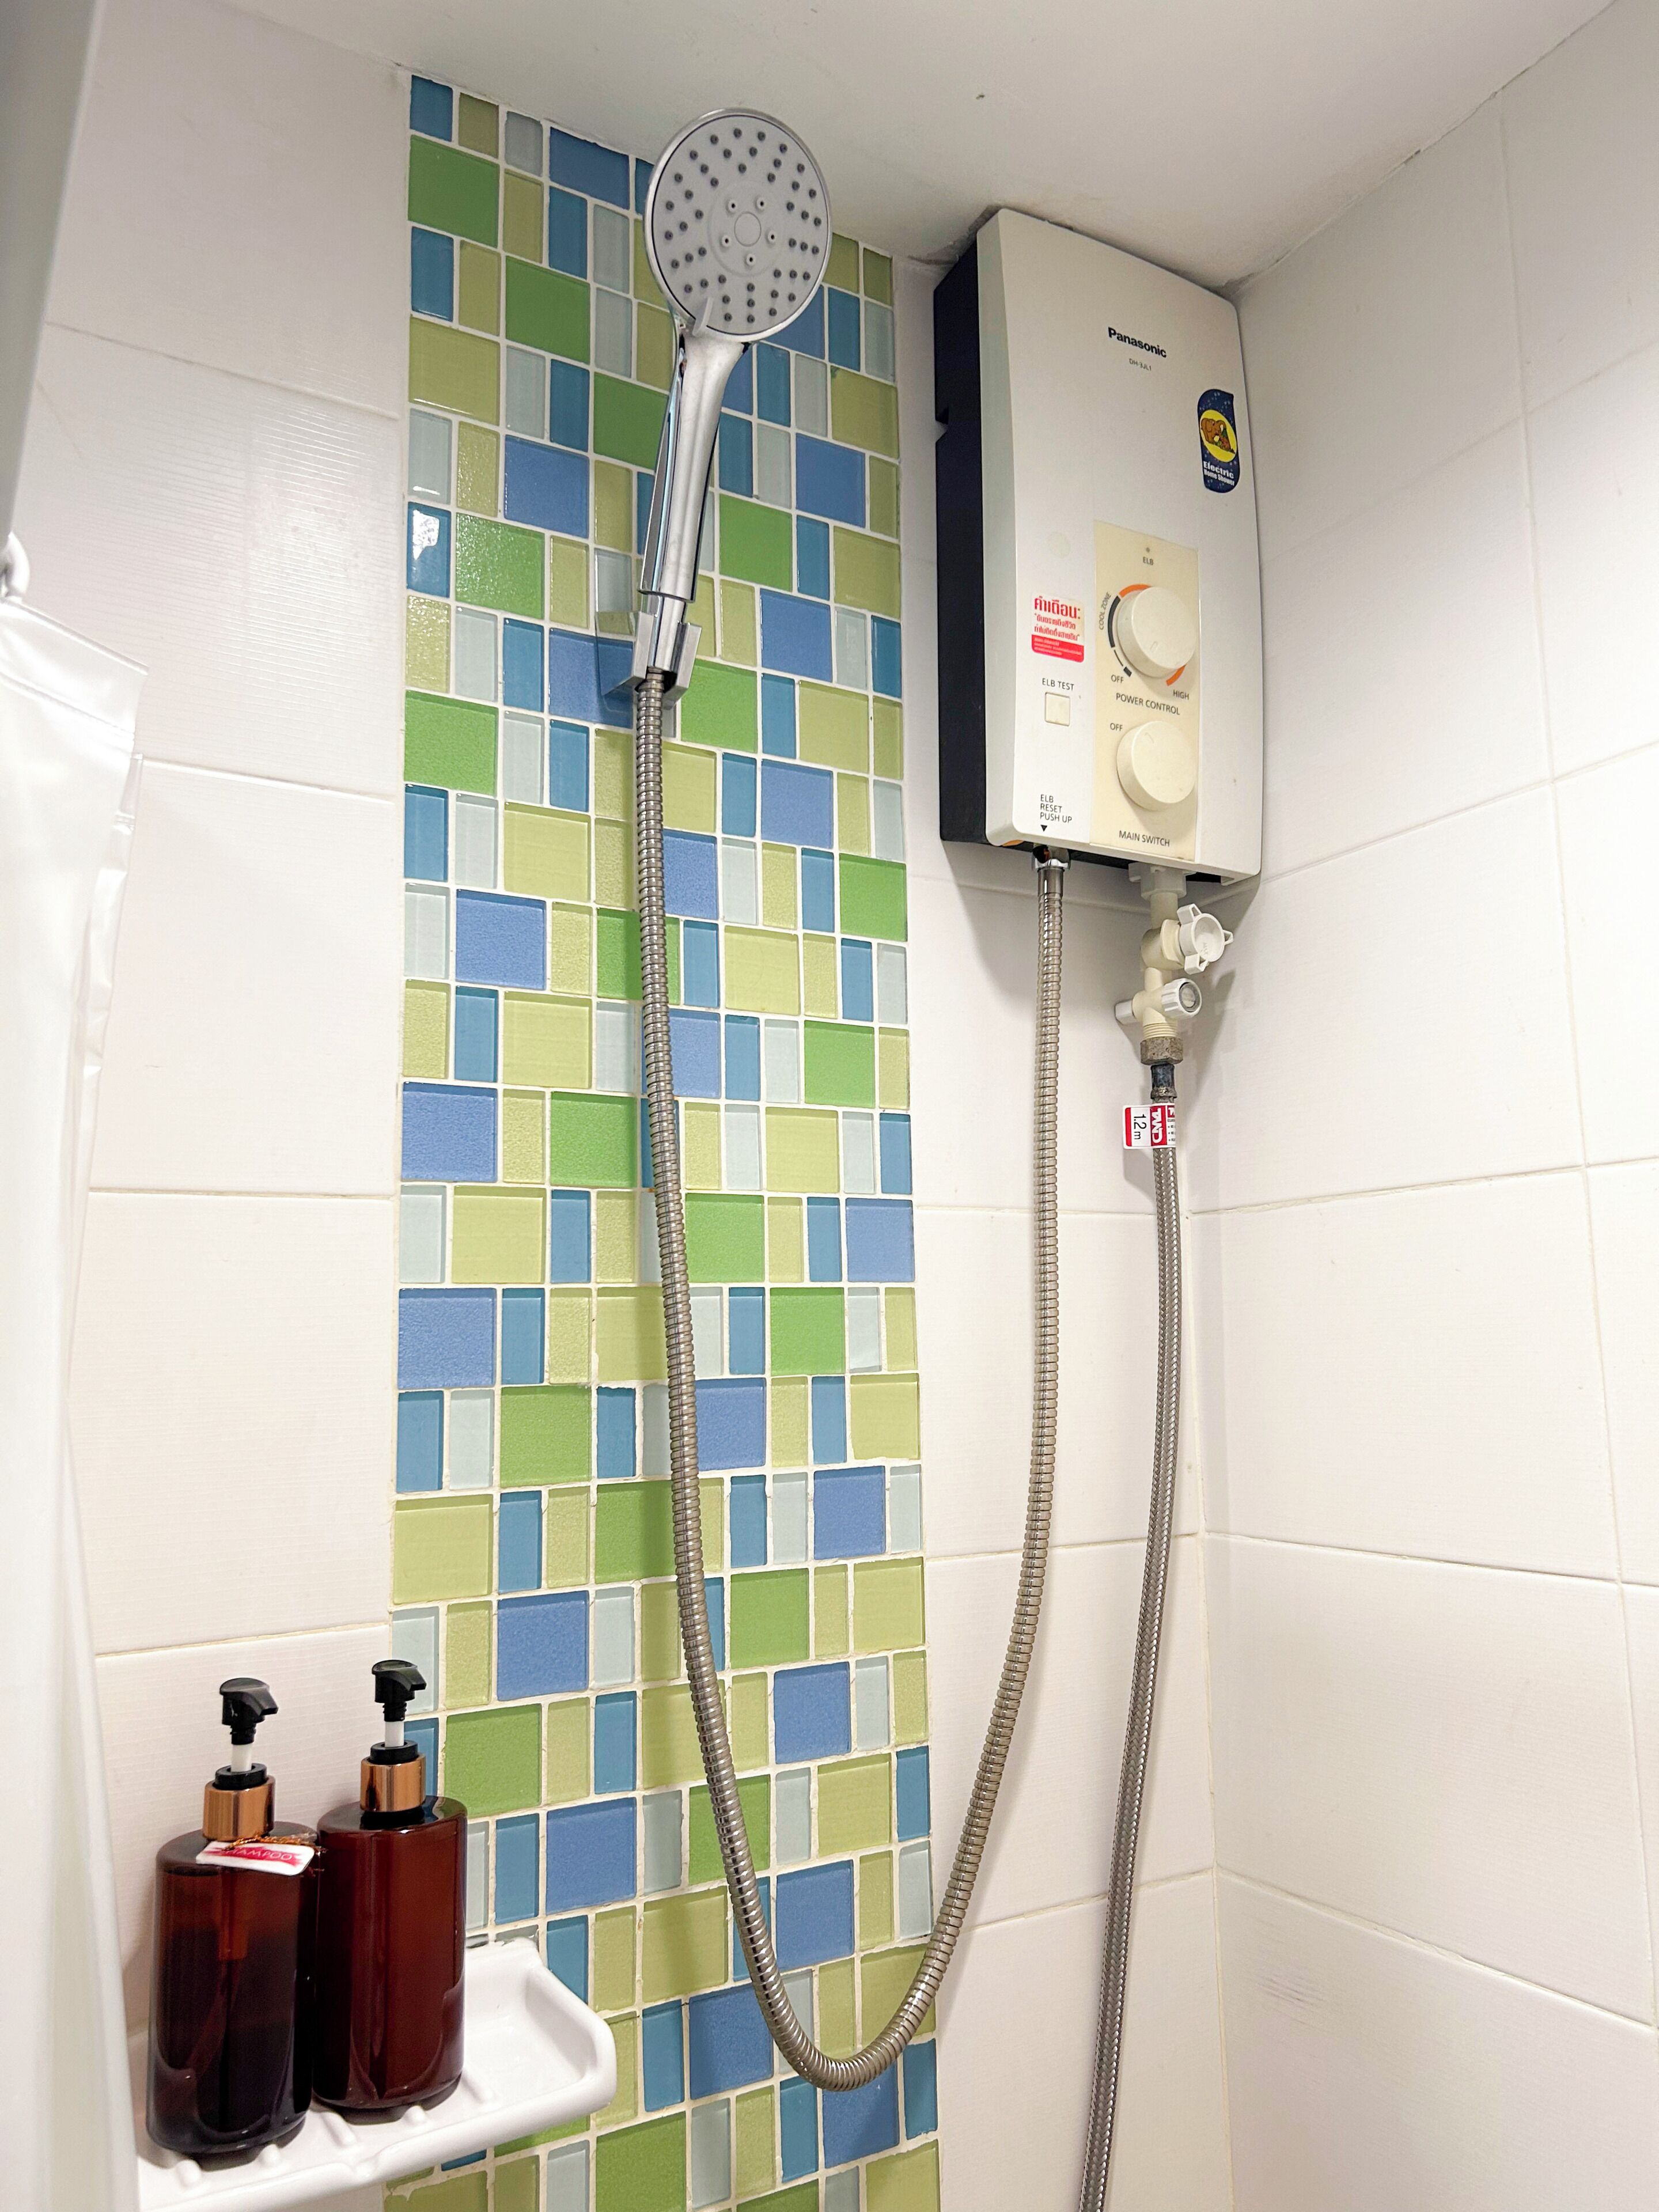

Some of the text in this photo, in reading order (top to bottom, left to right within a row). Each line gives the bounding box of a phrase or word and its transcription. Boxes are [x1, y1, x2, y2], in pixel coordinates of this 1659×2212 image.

[1108, 327, 1167, 358] Panasonic
[1203, 461, 1234, 479] Electric
[1203, 468, 1218, 479] Home
[1142, 556, 1154, 565] ELB
[1101, 592, 1112, 610] ZONE
[1042, 677, 1074, 691] ELB TEST
[1111, 674, 1124, 683] OFF
[1173, 690, 1190, 700] HIGH
[1116, 692, 1180, 715] POWER CONTROL
[1109, 722, 1123, 732] OFF
[1040, 794, 1054, 803] ELB
[1040, 802, 1062, 813] RESET
[1040, 812, 1072, 823] PUSH UP
[1119, 830, 1170, 847] MAIN SWITCH
